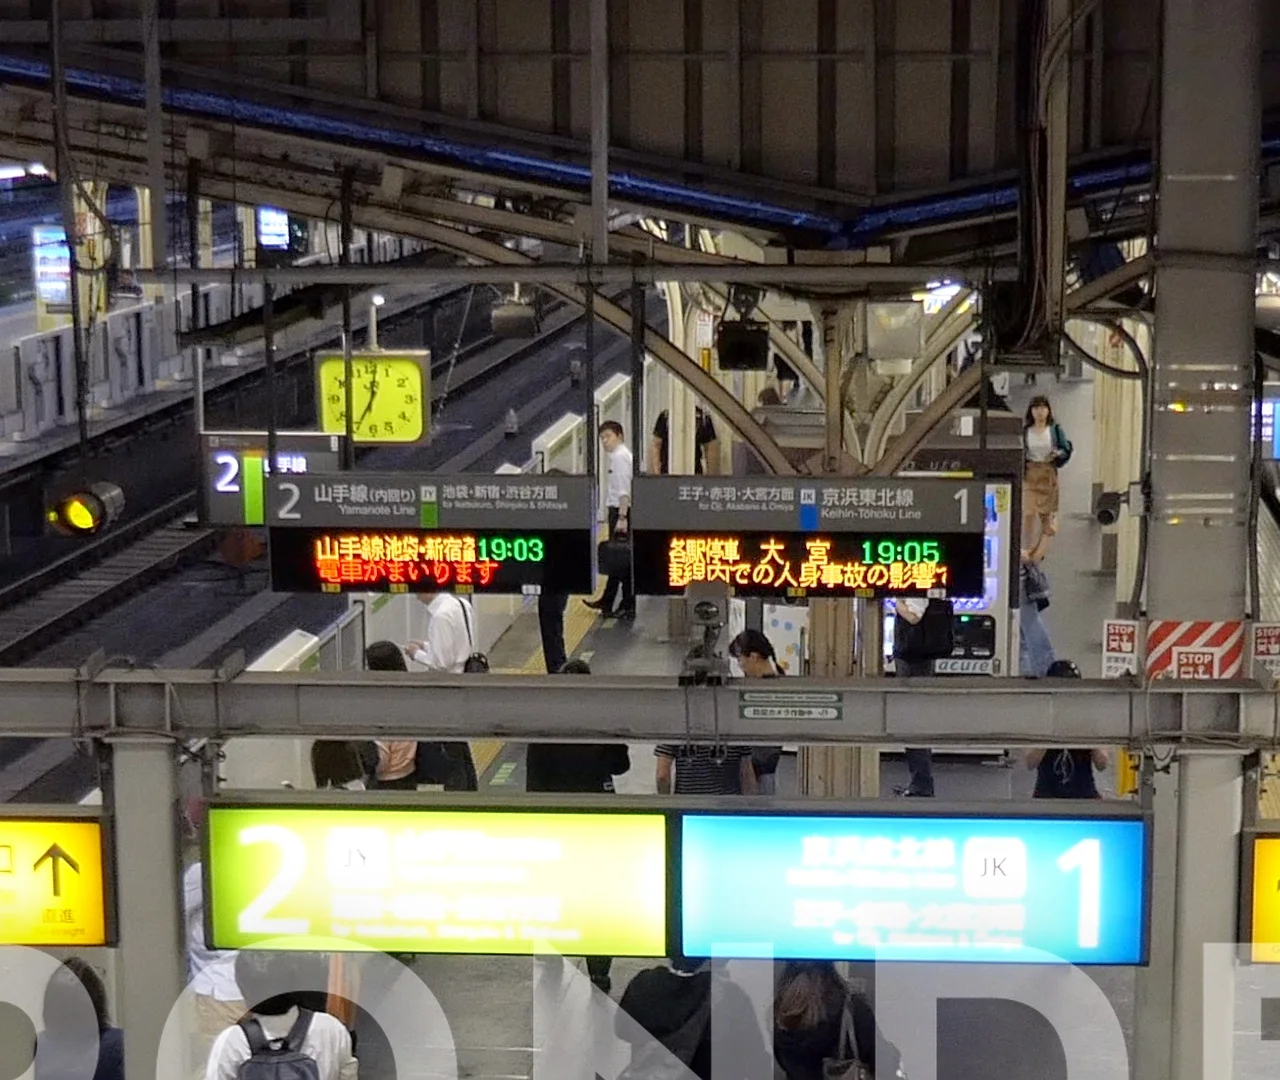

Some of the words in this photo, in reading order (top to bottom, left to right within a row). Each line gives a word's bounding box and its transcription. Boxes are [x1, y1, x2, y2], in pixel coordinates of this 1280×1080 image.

[216, 455, 240, 493] 2
[263, 456, 308, 474] 手線
[278, 482, 302, 519] 2
[821, 488, 914, 507] 京浜東北線
[954, 488, 968, 525] 1
[338, 504, 391, 516] Yamanote
[393, 504, 416, 516] Line
[899, 508, 922, 520] Line
[478, 538, 544, 562] 19:03
[670, 538, 740, 564] 各駅停車
[861, 540, 940, 565] 19:05
[317, 559, 499, 584] 電車がまいります
[1108, 624, 1134, 634] STOP
[938, 660, 990, 671] acure
[1178, 653, 1214, 665] STOP
[979, 857, 1008, 877] JK
[236, 824, 311, 935] 2
[1057, 837, 1102, 949] 1
